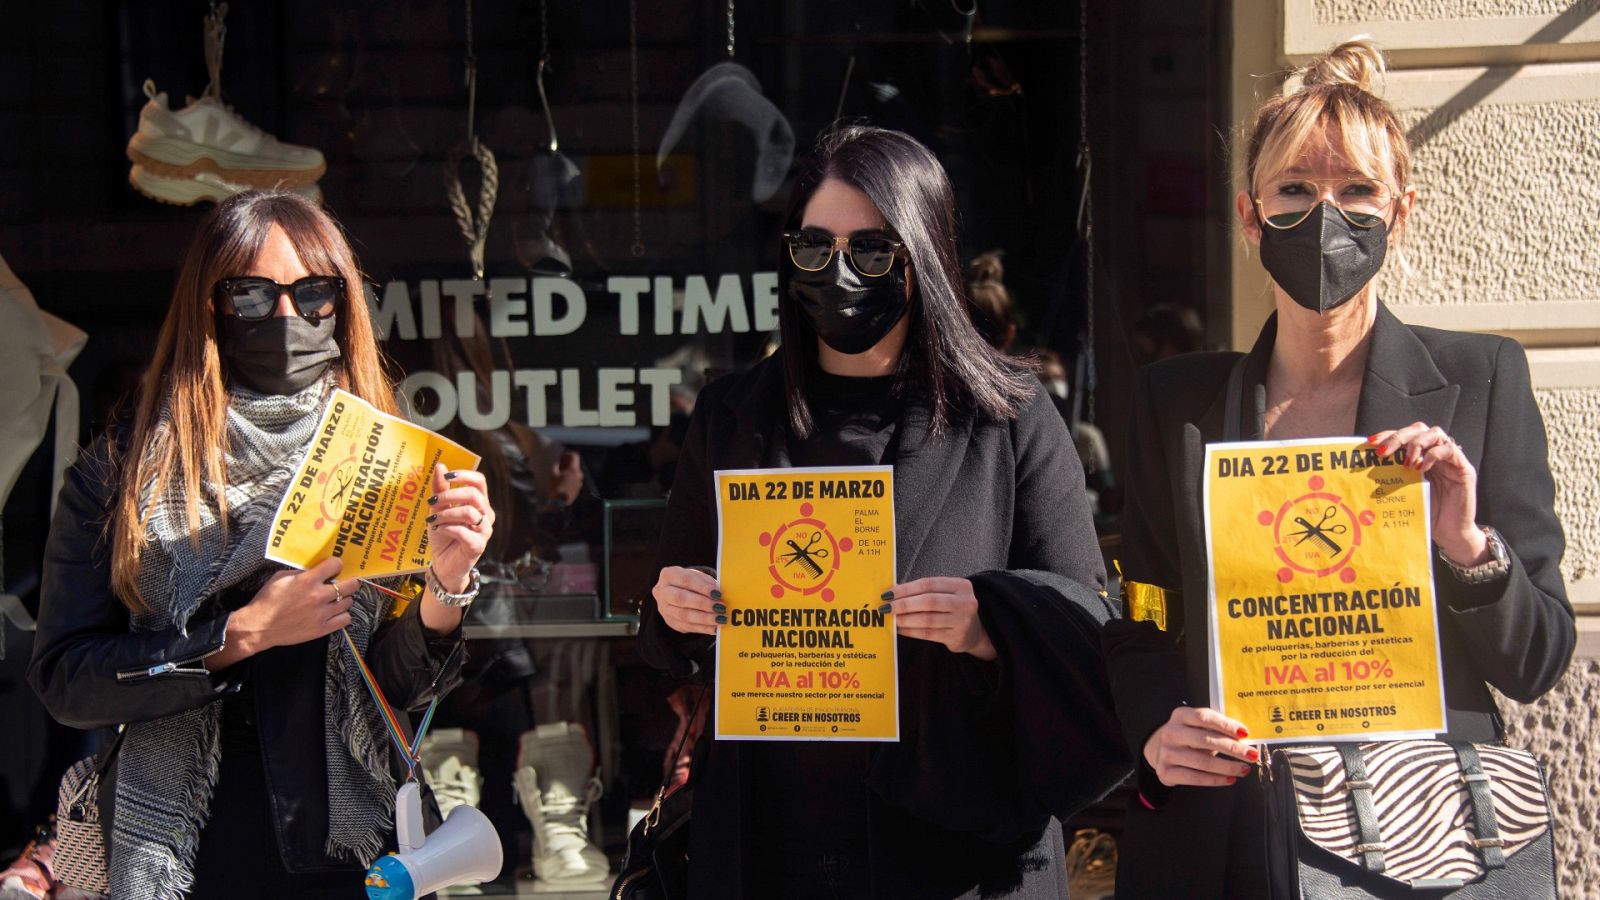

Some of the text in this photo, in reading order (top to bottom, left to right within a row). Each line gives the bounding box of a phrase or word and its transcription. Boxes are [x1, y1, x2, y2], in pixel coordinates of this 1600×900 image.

[364, 272, 780, 341] MITED TIME
[398, 368, 682, 431] OUTLET
[272, 401, 345, 548] DIA 22 DE MARZO
[1218, 457, 1255, 478] DIA
[1261, 455, 1290, 475] 22
[1296, 452, 1324, 472] DE
[332, 421, 384, 558] ONCENTRACIÓN
[729, 479, 885, 501] DIA 22 DE MARZO
[1375, 477, 1404, 486] PALMA
[350, 458, 391, 546] NACIONAL
[376, 471, 404, 543] por la reducción del
[1376, 495, 1407, 504] BORNE
[380, 465, 424, 561] IVA al 10%
[402, 521, 414, 546] nuestro
[412, 498, 421, 520] sector
[1382, 509, 1415, 519] DE 10H
[1392, 520, 1409, 528] 11H
[1305, 551, 1320, 559] IVA
[360, 560, 366, 570] de
[1227, 582, 1421, 619] CONCENTRACIÓN
[731, 604, 885, 628] CONCENTRACIÓN
[1267, 613, 1384, 640] NACIONAL
[762, 629, 854, 648] NACIONAL
[1241, 636, 1414, 654] de peluquerías, barberías y estéticas
[751, 651, 797, 660] peluquerías,
[798, 651, 835, 659] barberías
[842, 651, 877, 659] estéticas
[794, 660, 832, 668] reducción
[1281, 648, 1375, 661] por la reducción del
[755, 671, 860, 689] IVA al 10%
[1263, 658, 1394, 685] IVA al 10%
[1237, 690, 1255, 698] que
[1256, 689, 1288, 697] merece
[1290, 687, 1324, 695] nuestro
[1325, 684, 1353, 693] sector
[1355, 683, 1370, 692] por
[1388, 680, 1425, 689] esencial
[772, 712, 861, 723] CREER EN NOSOTROS
[1288, 705, 1397, 721] CREER EN NOSOTROS
